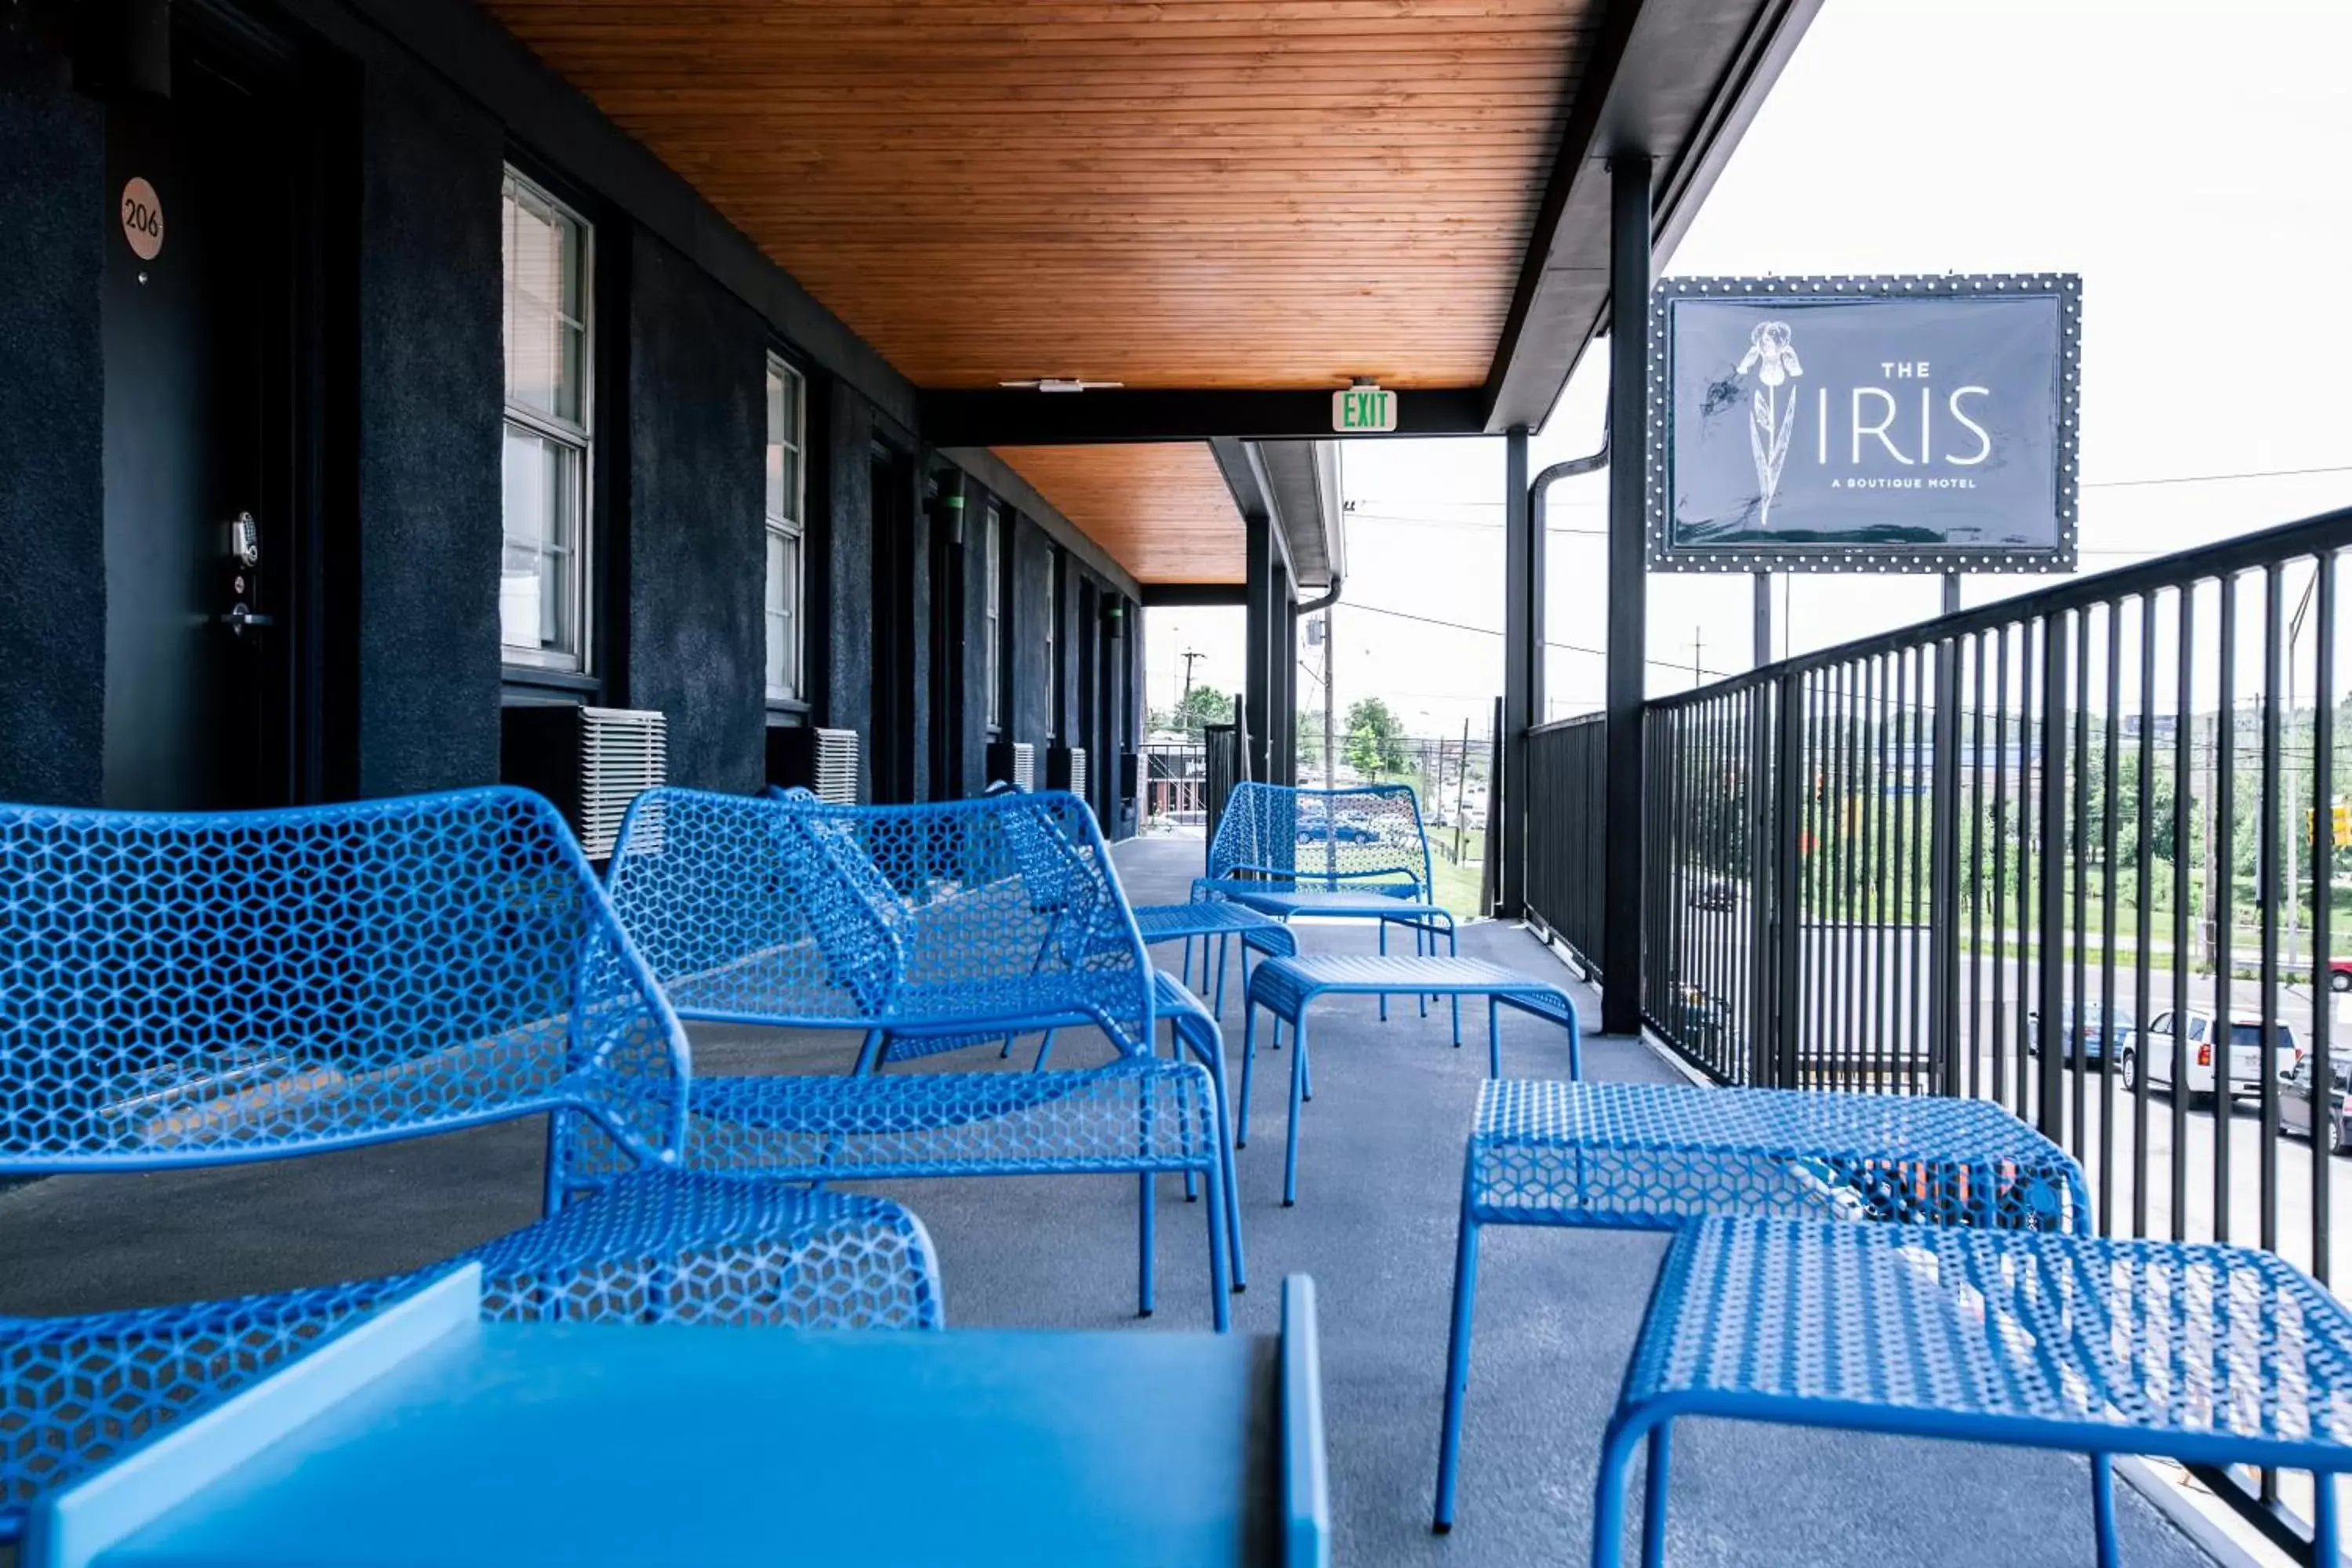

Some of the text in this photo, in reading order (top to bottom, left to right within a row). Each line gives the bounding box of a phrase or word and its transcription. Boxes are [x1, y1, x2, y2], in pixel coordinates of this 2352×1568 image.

[125, 199, 158, 237] 206
[1882, 362, 1929, 378] THE
[1344, 393, 1388, 426] EXIT
[1819, 387, 1991, 464] IRIS
[1831, 478, 1976, 488] A BOUTIQUE MOTEL
